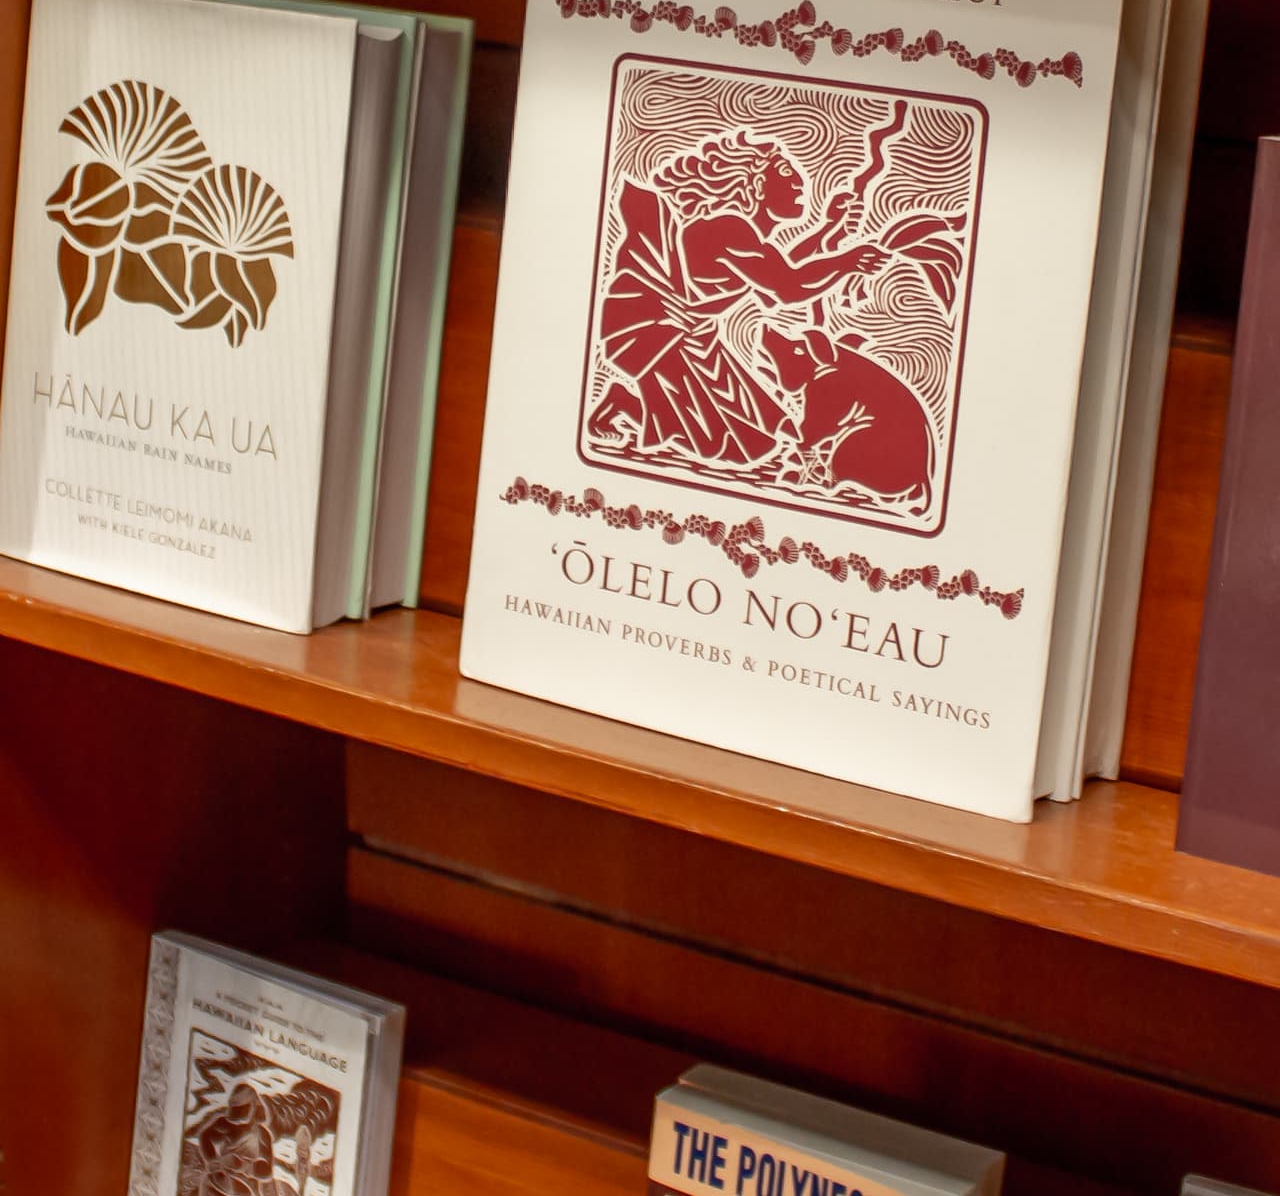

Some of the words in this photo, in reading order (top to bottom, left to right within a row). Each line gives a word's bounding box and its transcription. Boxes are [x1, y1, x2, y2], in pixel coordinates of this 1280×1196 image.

[33, 371, 154, 431] HĀNAU
[170, 404, 216, 446] KA
[231, 416, 279, 462] UA
[65, 424, 137, 453] HAWAIIAN
[143, 442, 178, 462] RAIN
[183, 452, 233, 475] NAMES
[45, 477, 122, 512] COLLETTE
[127, 499, 195, 530] LEIMOMI
[198, 516, 254, 544] AKANA
[78, 514, 108, 531] WITH
[148, 532, 217, 560] GONZALEZ
[504, 594, 613, 637] HAWAIIAN
[621, 624, 733, 667] PROVERBS
[742, 655, 756, 672] &
[768, 660, 881, 703] POETICAL
[892, 690, 992, 730] SAYINGS
[268, 1028, 348, 1074] LANGUAGE
[672, 1120, 729, 1191] THE
